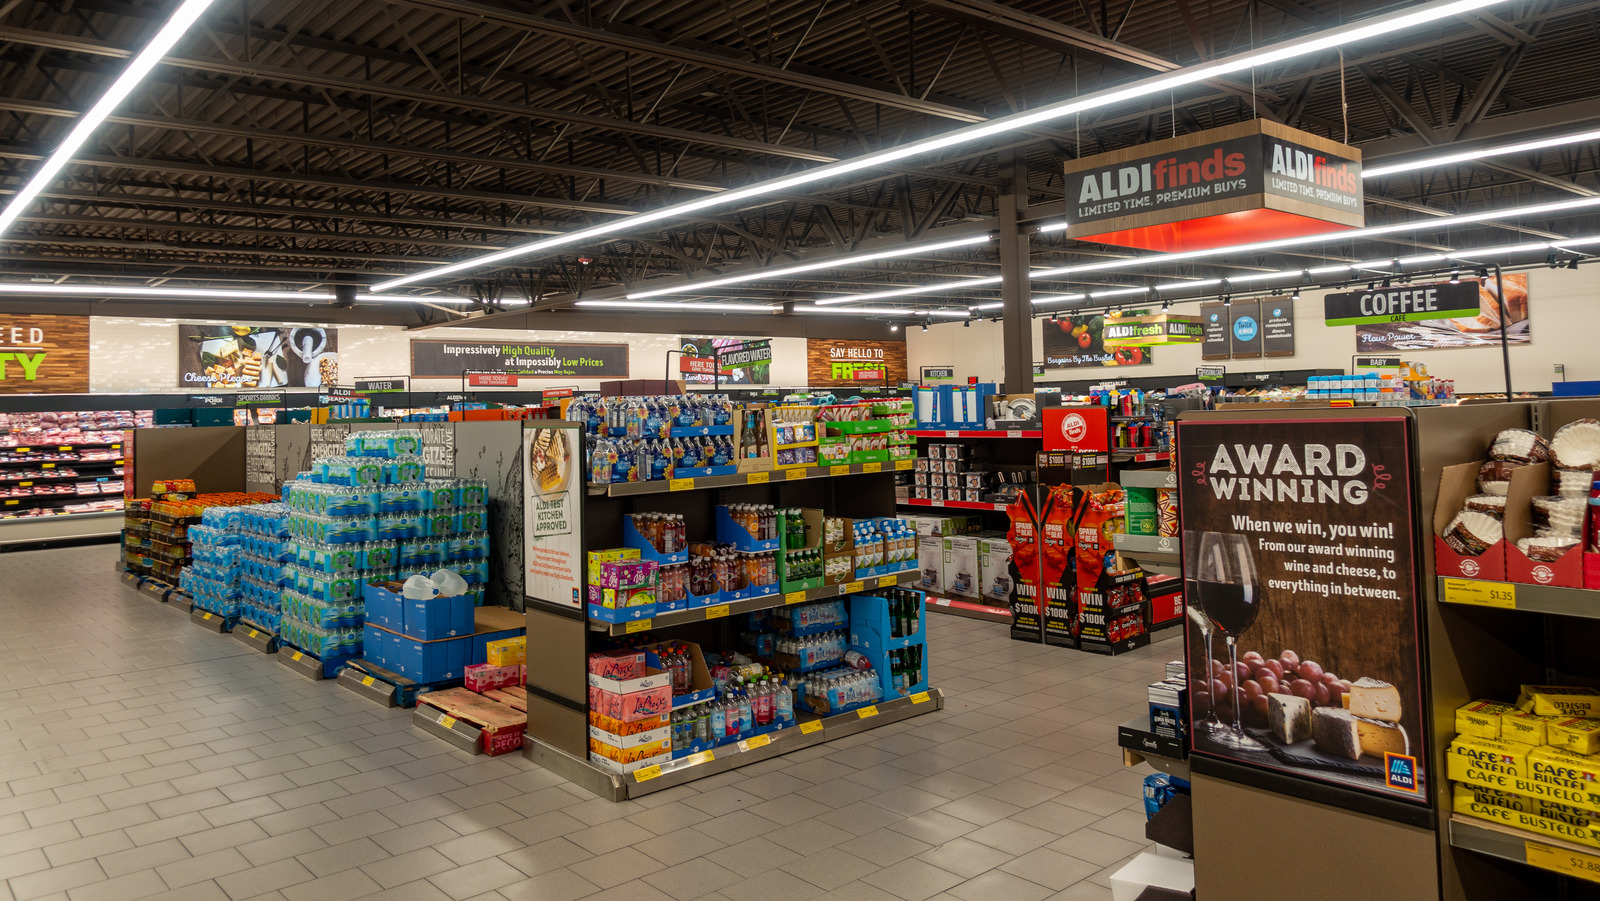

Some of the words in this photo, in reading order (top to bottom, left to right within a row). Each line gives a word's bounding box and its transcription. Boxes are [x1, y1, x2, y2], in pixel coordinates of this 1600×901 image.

[1078, 202, 1120, 217] LIMITED
[1123, 197, 1153, 209] TIME,
[1156, 185, 1210, 204] PREMIUM
[1214, 179, 1247, 194] BUYS
[1272, 177, 1298, 193] LIMITED
[1316, 189, 1343, 205] PREMIUM
[1343, 195, 1357, 207] BUYS
[1360, 289, 1437, 316] COFFEE
[1361, 334, 1387, 343] Flour
[1387, 332, 1416, 341] Power
[444, 344, 500, 357] Impressively
[502, 345, 522, 358] High
[524, 346, 555, 357] Quality
[722, 351, 750, 366] FLAVORED
[750, 348, 771, 361] WATER
[830, 348, 845, 358] SAY
[848, 348, 872, 358] HELLO
[874, 349, 884, 358] TO
[505, 357, 514, 366] at
[516, 357, 561, 368] Impossibly
[563, 358, 578, 366] Low
[580, 358, 604, 366] Prices
[1047, 357, 1072, 365] Bargains
[1072, 356, 1081, 364] By
[1093, 353, 1114, 361] Bushel
[184, 372, 217, 382] Cheese
[218, 372, 252, 382] Please
[368, 382, 392, 390] WATER
[421, 429, 445, 444] YDRATE
[423, 446, 446, 465] GIZE
[1209, 443, 1366, 476] AWARD
[1209, 476, 1368, 505] WINNING
[536, 501, 549, 510] ALDI
[550, 499, 564, 508] TEST
[538, 510, 563, 520] KITCHEN
[536, 521, 567, 531] APPROVED
[1015, 522, 1032, 530] SPARK
[1045, 524, 1062, 532] SPARK
[1231, 515, 1270, 532] When
[1273, 522, 1293, 533] we
[1295, 519, 1327, 538] win,
[1329, 524, 1357, 540] you
[1359, 522, 1394, 539] win!
[1259, 538, 1285, 552] From
[1288, 542, 1306, 553] our
[1308, 542, 1343, 556] award
[1345, 545, 1395, 563] winning
[1284, 560, 1310, 572] wine
[1312, 562, 1333, 575] and
[1335, 563, 1381, 580] cheese,
[1382, 567, 1396, 579] to
[1016, 584, 1037, 597] WIN
[1046, 587, 1067, 600] WIN
[1268, 579, 1329, 597] everything
[1331, 584, 1341, 595] in
[1344, 585, 1401, 600] between.
[1490, 590, 1512, 600] $1.35
[1080, 592, 1103, 606] WIN
[1015, 602, 1038, 615] $100K
[1045, 607, 1068, 619] $100K
[1080, 612, 1105, 625] $100K
[603, 664, 633, 678] LaCroix
[633, 696, 667, 715] LaCroix
[1554, 701, 1591, 710] BUSTELO
[1391, 774, 1412, 784] ALDI
[1516, 780, 1584, 803] BUSTELO
[1519, 814, 1587, 839] BUSTELO
